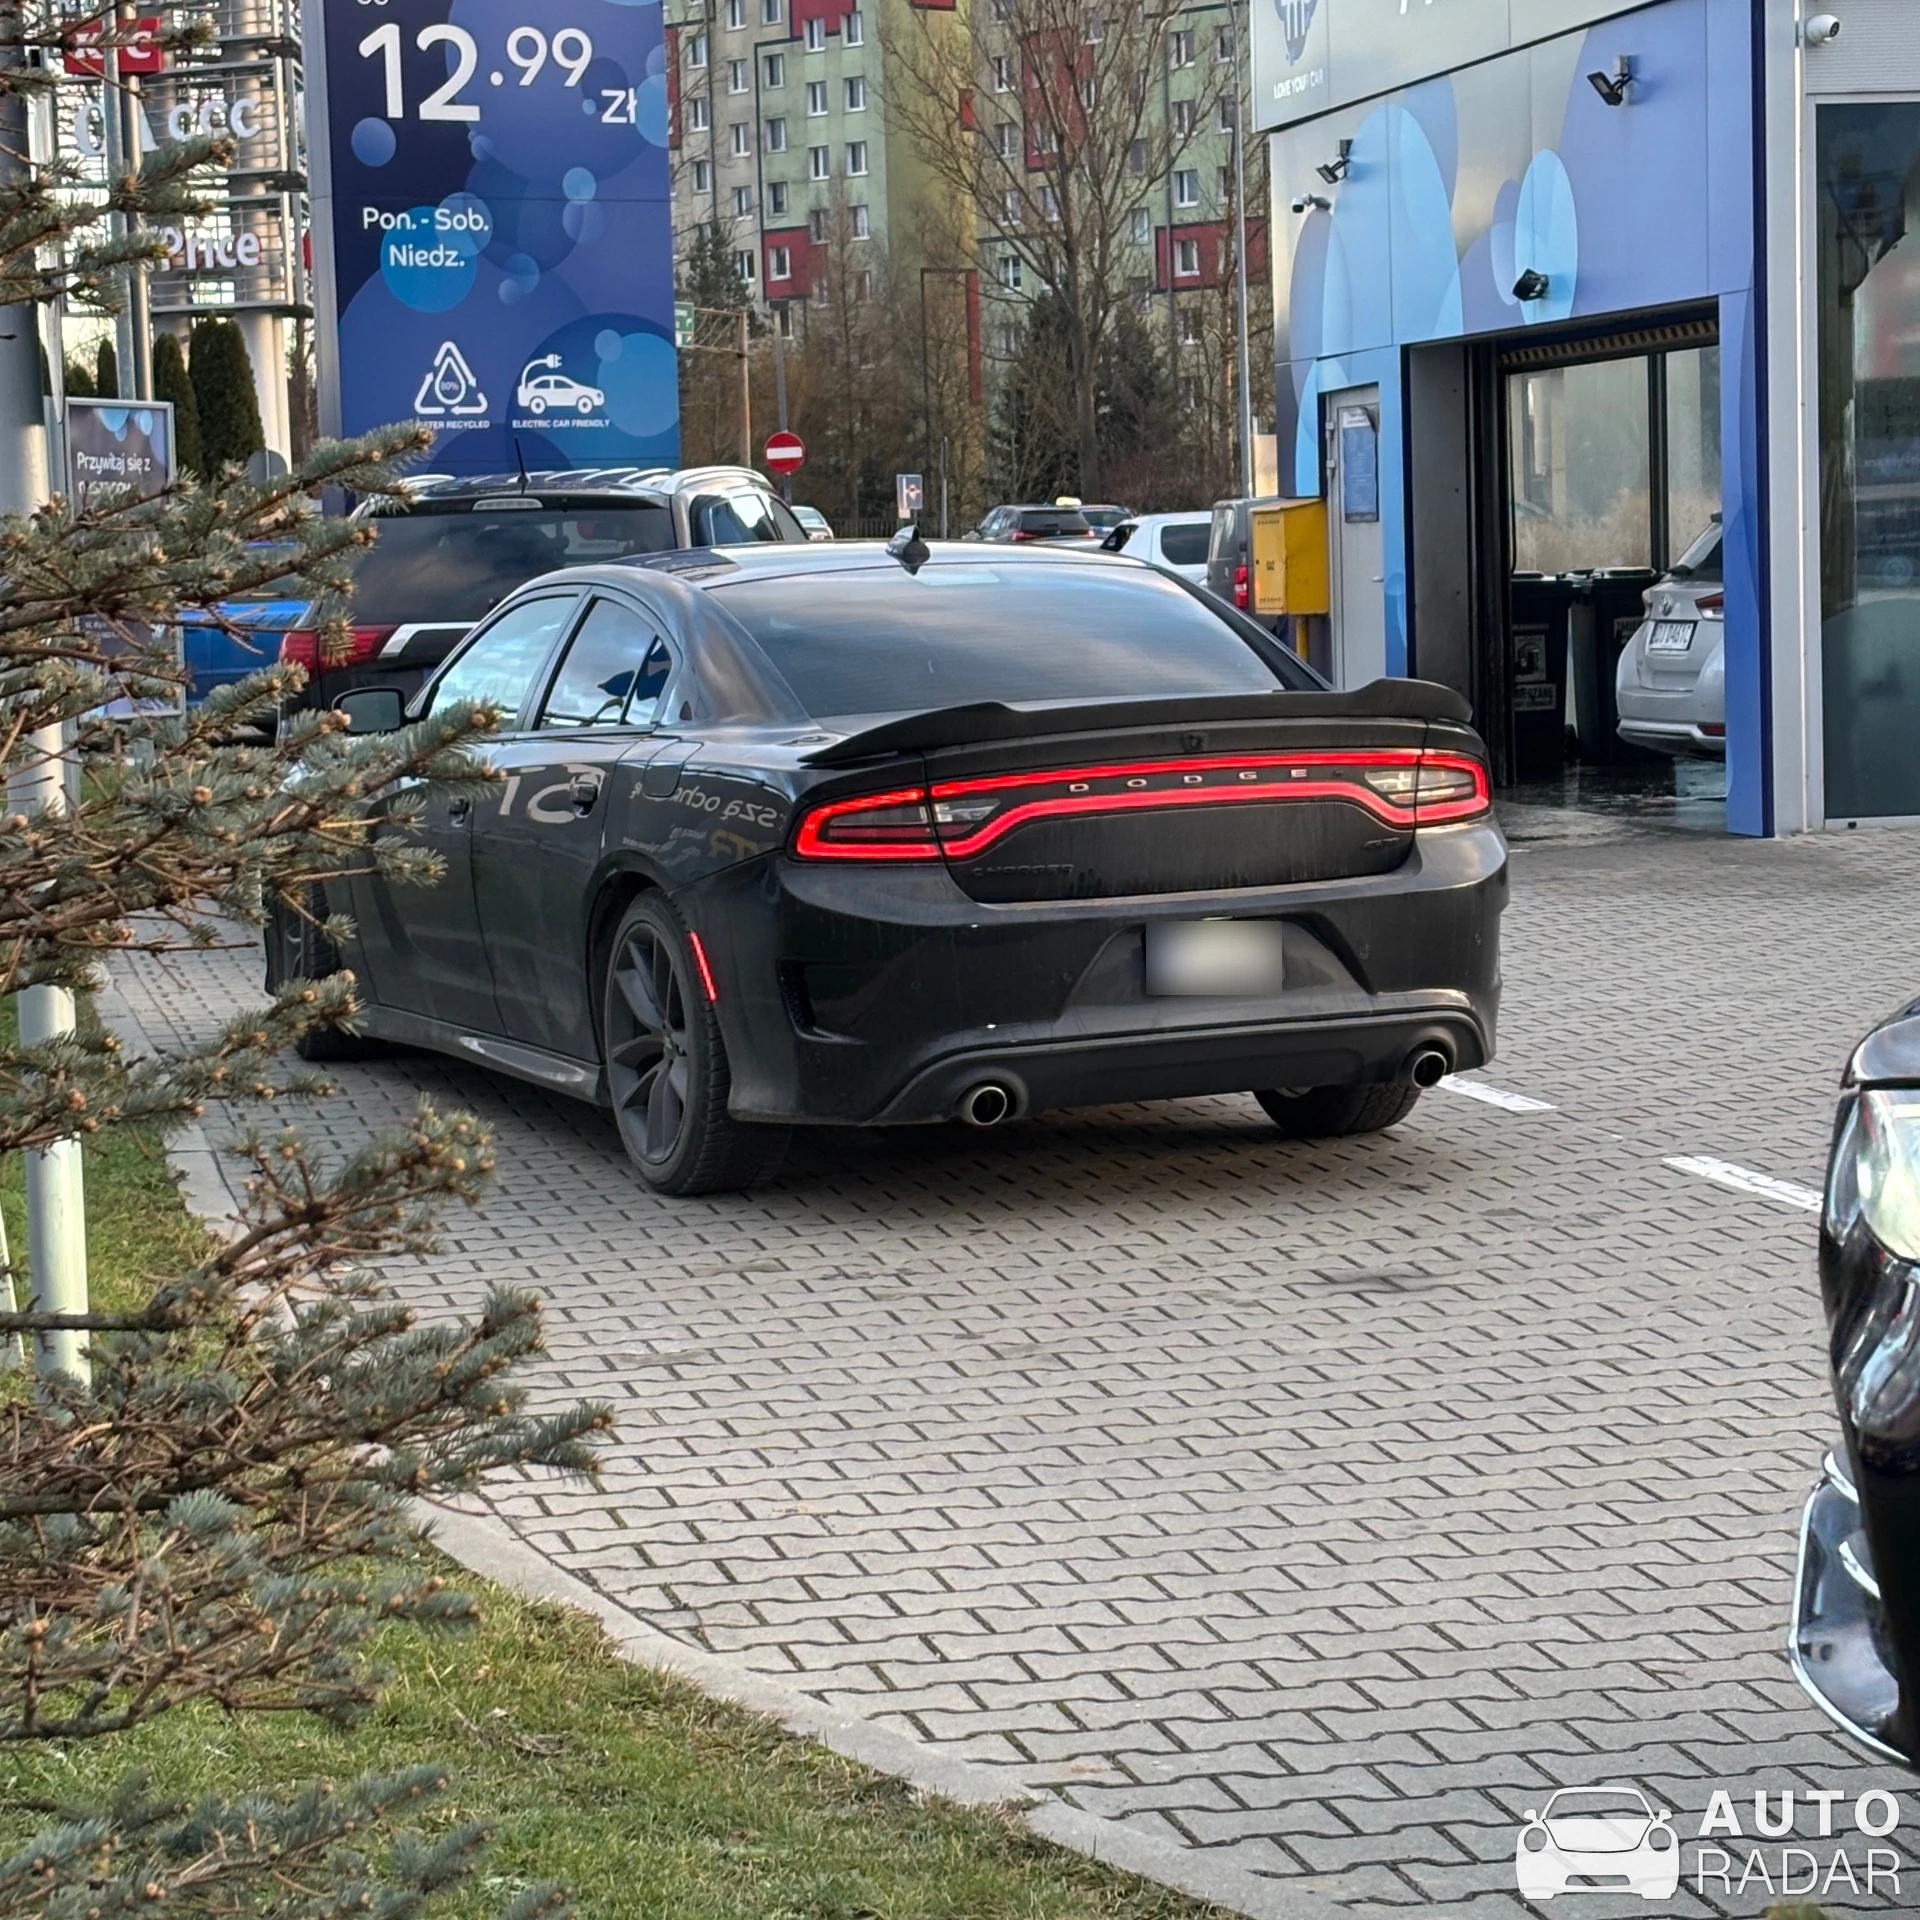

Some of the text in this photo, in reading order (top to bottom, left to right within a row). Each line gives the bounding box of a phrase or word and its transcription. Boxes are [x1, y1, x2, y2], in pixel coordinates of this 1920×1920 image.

[74, 31, 152, 59] KC
[389, 244, 465, 267] Niedz.
[446, 420, 491, 429] RECYCLED
[512, 419, 611, 429] ELECTRIC CAR FRIENDLY
[76, 451, 151, 476] Przywitaj się z
[1069, 768, 1308, 793] DODGE
